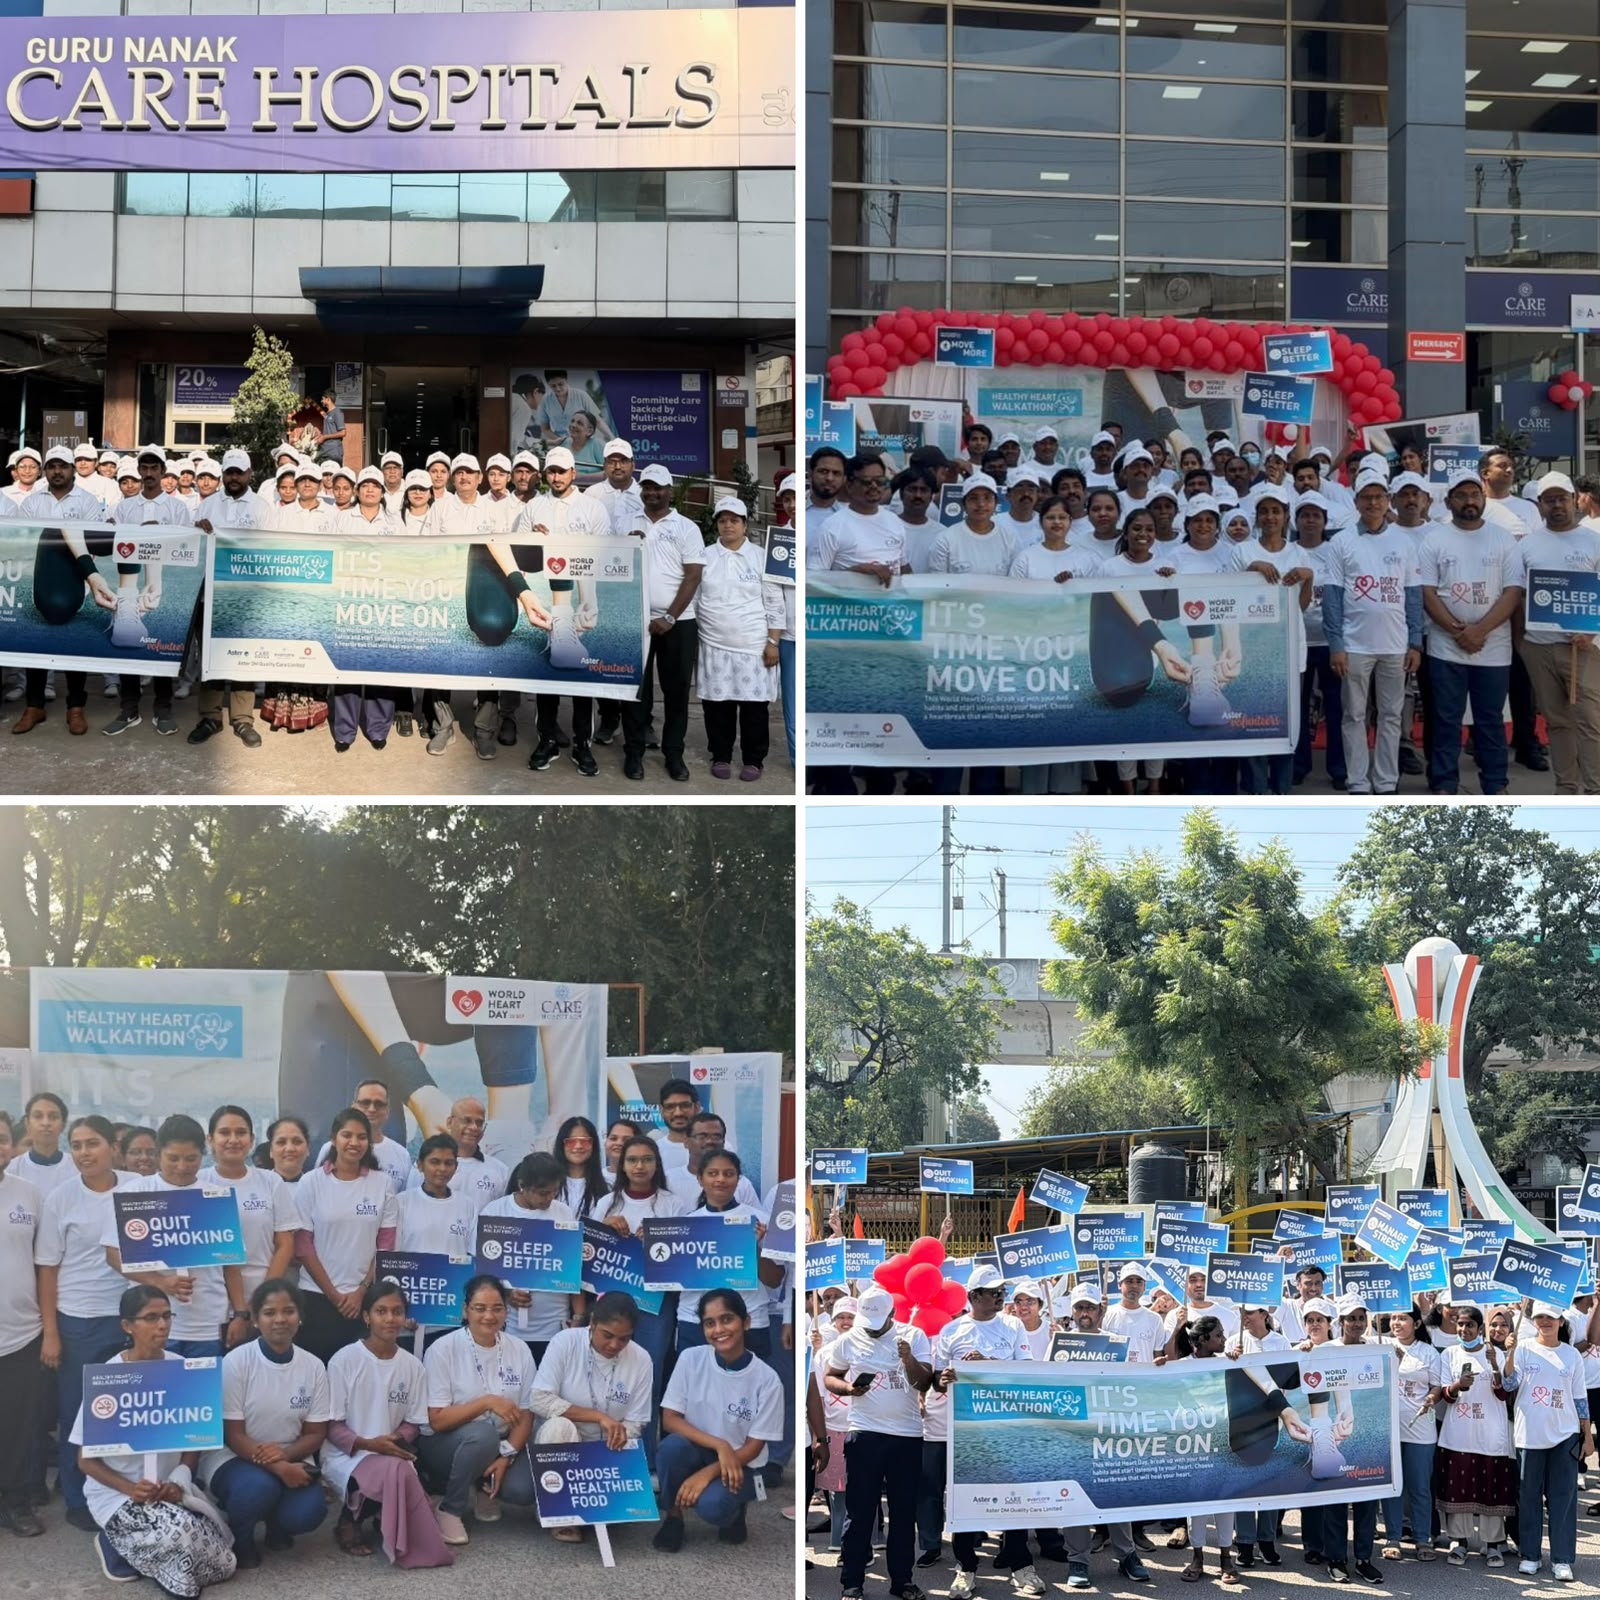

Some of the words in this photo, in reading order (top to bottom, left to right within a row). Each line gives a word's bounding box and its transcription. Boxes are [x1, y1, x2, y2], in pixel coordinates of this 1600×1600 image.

[26, 38, 114, 63] GURU
[124, 36, 238, 62] NANAK
[6, 66, 228, 131] CARE
[252, 61, 722, 131] HOSPITALS
[1347, 293, 1388, 307] CARE
[1505, 297, 1546, 311] CARE
[951, 341, 975, 349] MOVE
[1413, 339, 1458, 348] EMERGENCY
[1281, 346, 1312, 355] SLEEP
[1282, 353, 1320, 364] BETTER
[179, 368, 217, 387] 20%
[631, 396, 679, 405] Committed
[1030, 393, 1056, 401] HEART
[1261, 389, 1295, 400] SLEEP
[631, 405, 663, 413] backed
[664, 405, 675, 414] by
[992, 402, 1053, 411] WALKATHON
[1260, 400, 1300, 411] BETTER
[631, 414, 698, 424] Multi-specialty
[1518, 417, 1550, 428] CARE
[631, 423, 674, 432] Expertise
[632, 439, 660, 452] 30+
[860, 440, 902, 448] WALKATHON
[1446, 459, 1479, 468] SLEEP
[171, 549, 195, 559] CARE
[230, 554, 271, 564] HEALTHY
[274, 555, 304, 564] HEART
[338, 551, 382, 572] IT'S
[230, 565, 300, 577] WALKATHON
[604, 566, 629, 574] CARE
[335, 577, 397, 600] TIME
[404, 579, 453, 601] YOU
[1552, 590, 1598, 603] SLEEP
[845, 605, 886, 616] HEART
[929, 601, 986, 628] IT'S
[1248, 604, 1275, 614] CARE
[336, 602, 405, 627] MOVE
[413, 605, 456, 629] ON.
[139, 636, 158, 644] Aster
[927, 633, 1004, 661] TIME
[1014, 635, 1075, 662] YOU
[581, 657, 600, 665] Aster
[926, 665, 1017, 693] MOVE
[1026, 667, 1080, 692] ON.
[1221, 711, 1242, 719] Aster
[488, 990, 526, 999] WORLD
[488, 1000, 521, 1009] HEART
[541, 1001, 582, 1014] CARE
[65, 1010, 136, 1025] HEALTHY
[141, 1013, 193, 1027] HEART
[488, 1010, 508, 1019] DAY
[68, 1027, 186, 1047] WALKATHON
[825, 1160, 852, 1168] SLEEP
[825, 1167, 857, 1175] BETTER
[934, 1169, 952, 1177] QUIT
[934, 1176, 969, 1185] SMOKING
[1048, 1183, 1072, 1197] SLEEP
[1046, 1190, 1074, 1205] BETTER
[1341, 1197, 1363, 1205] MOVE
[1409, 1202, 1431, 1210] MOVE
[149, 1215, 191, 1231] QUIT
[1289, 1222, 1306, 1230] QUIT
[151, 1228, 234, 1247] SMOKING
[1093, 1228, 1126, 1236] CHOOSE
[1376, 1221, 1409, 1245] MANAGE
[1093, 1235, 1139, 1243] HEALTHIER
[1174, 1234, 1219, 1247] MANAGE
[1372, 1229, 1401, 1252] STRESS
[503, 1241, 553, 1257] SLEEP
[671, 1241, 717, 1255] MOVE
[1018, 1245, 1043, 1258] QUIT
[1093, 1243, 1115, 1251] FOOD
[1296, 1248, 1317, 1258] QUIT
[596, 1247, 632, 1268] QUIT
[696, 1256, 744, 1269] MORE
[1020, 1250, 1070, 1268] SMOKING
[1296, 1254, 1337, 1267] SMOKING
[502, 1256, 563, 1272] BETTER
[1519, 1260, 1552, 1278] MOVE
[1227, 1270, 1274, 1282] MANAGE
[401, 1276, 448, 1290] SLEEP
[1226, 1280, 1269, 1292] STRESS
[1359, 1280, 1391, 1290] SLEEP
[1532, 1275, 1567, 1294] MORE
[1360, 1289, 1399, 1300] BETTER
[1070, 1350, 1118, 1361] MANAGE
[1357, 1372, 1380, 1381] CARE
[119, 1390, 167, 1409] QUIT
[971, 1389, 1020, 1400] HEALTHY
[1022, 1390, 1055, 1400] HEART
[1091, 1385, 1137, 1408] IT'S
[972, 1401, 1053, 1414] WALKATHON
[119, 1406, 213, 1428] SMOKING
[1092, 1411, 1158, 1435] TIME
[1165, 1405, 1217, 1431] YOU
[1093, 1436, 1168, 1459] MOVE
[1175, 1433, 1219, 1455] ON.
[1338, 1464, 1356, 1472] Aster
[566, 1467, 621, 1482] CHOOSE
[568, 1480, 644, 1495] HEALTHIER
[571, 1495, 608, 1509] FOOD
